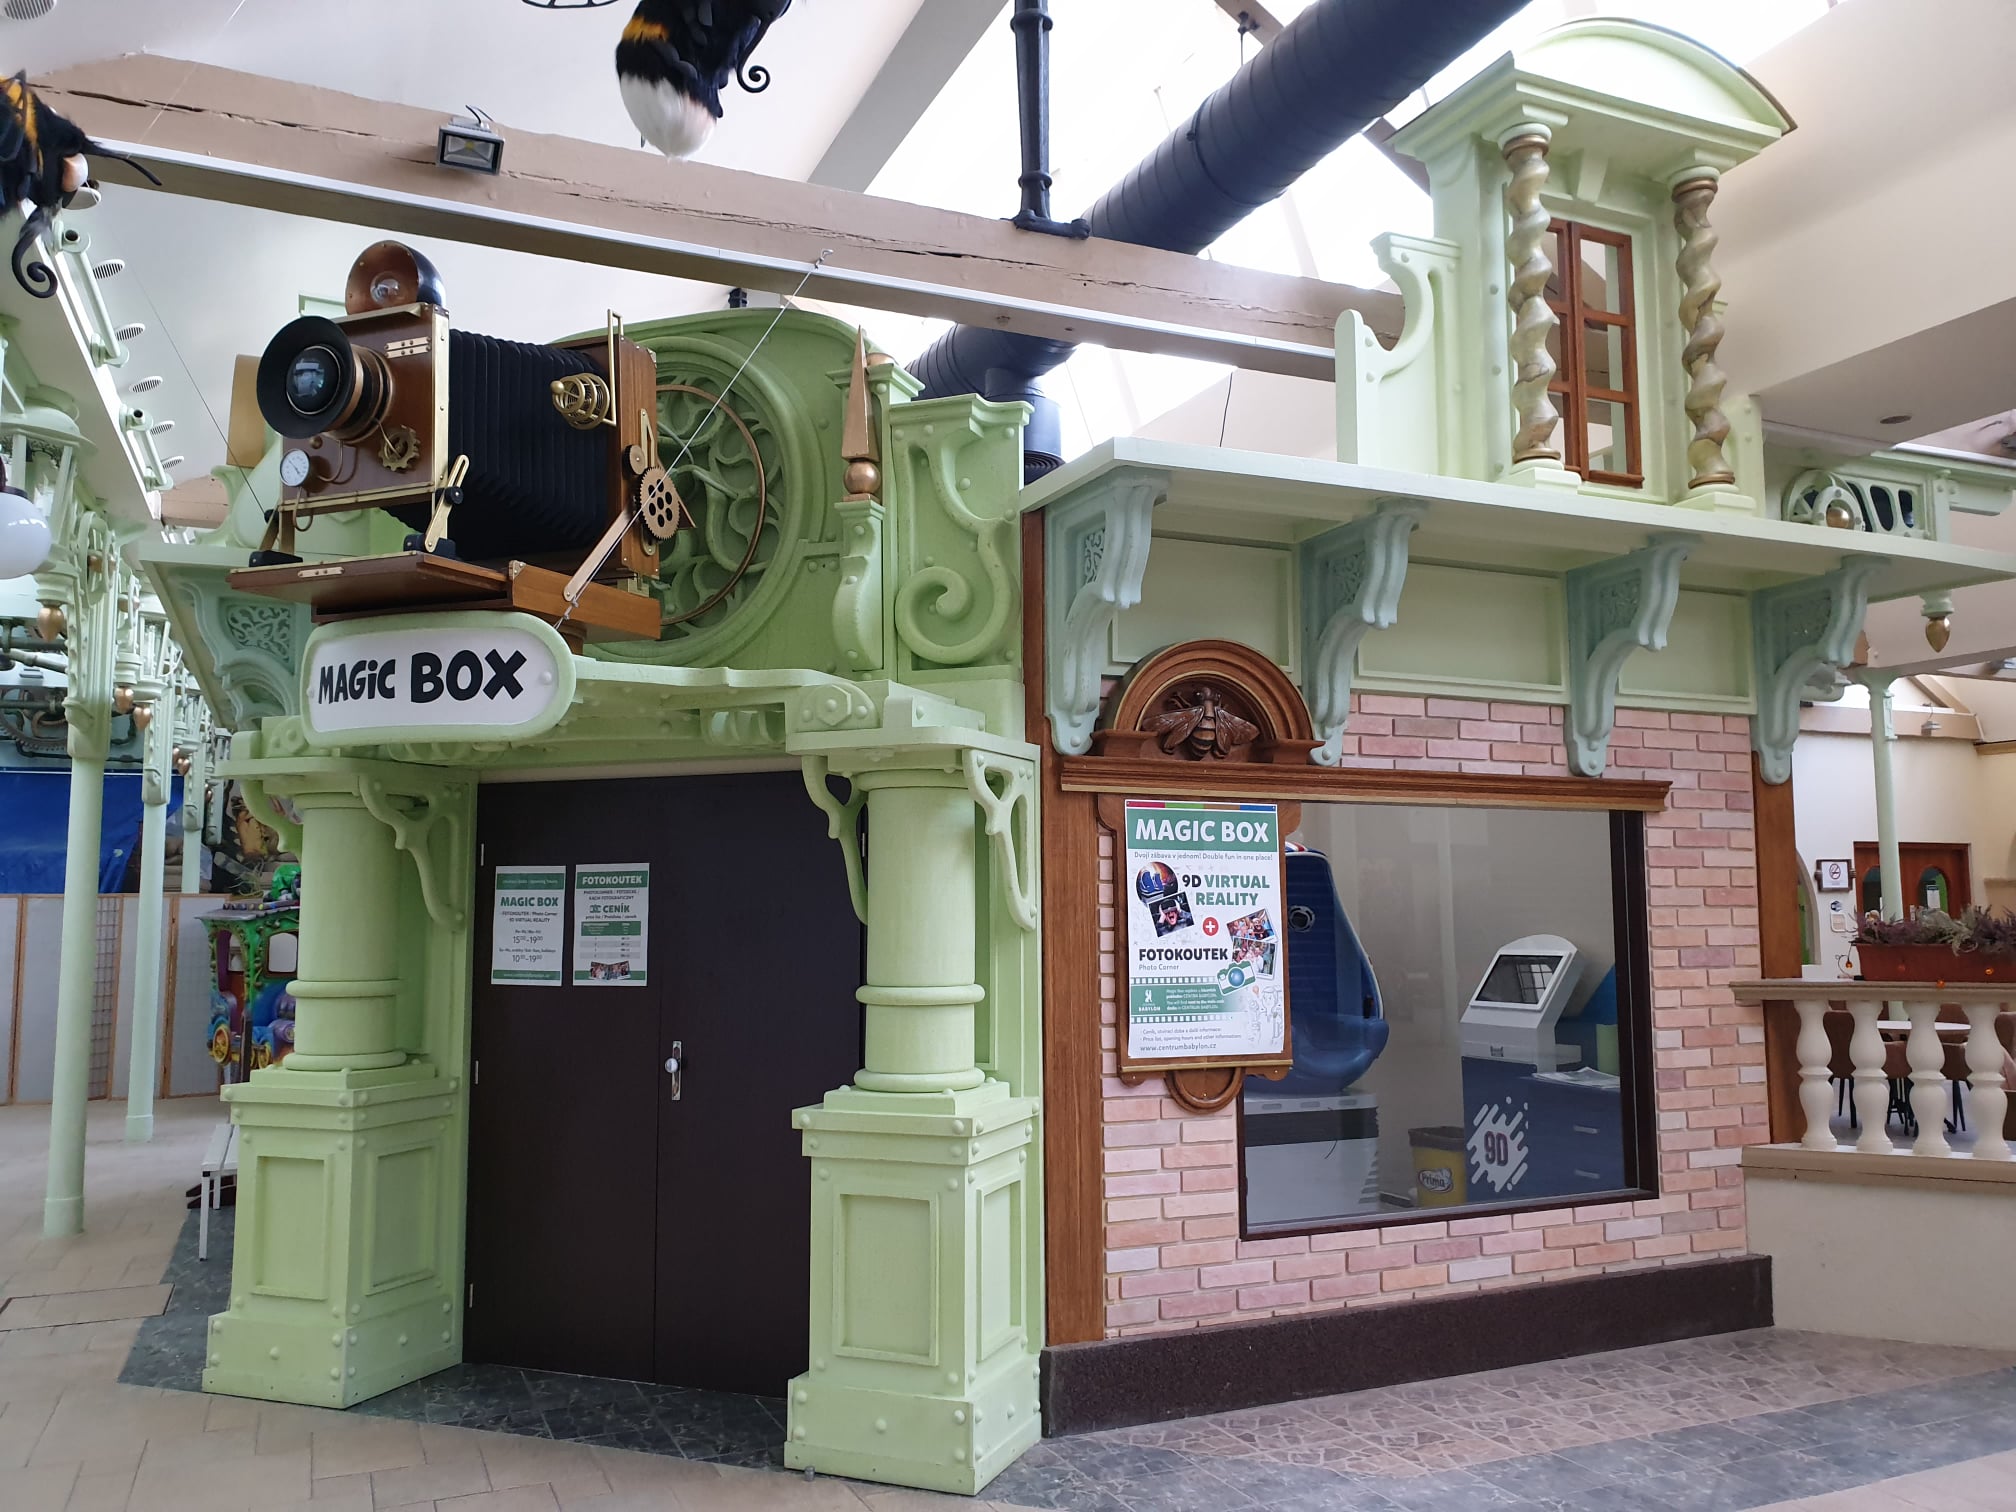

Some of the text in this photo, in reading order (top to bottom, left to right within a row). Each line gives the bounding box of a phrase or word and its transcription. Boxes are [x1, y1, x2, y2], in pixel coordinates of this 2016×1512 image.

[410, 648, 527, 703] BOX
[1135, 819, 1269, 843] MAGIC BOX
[582, 875, 642, 885] FOTOKOUTEK
[1182, 875, 1270, 889] 9D VIRTUAL
[500, 896, 558, 907] MAGIC BOX
[1196, 892, 1258, 906] REALITY
[602, 902, 630, 913] CENÍK
[1139, 948, 1228, 961] FOTOKOUTEK
[1158, 963, 1179, 971] Corner
[1140, 1043, 1217, 1052] www.centrumbabylon.cz
[1484, 1131, 1509, 1166] 9D
[1422, 1173, 1445, 1188] Prima
